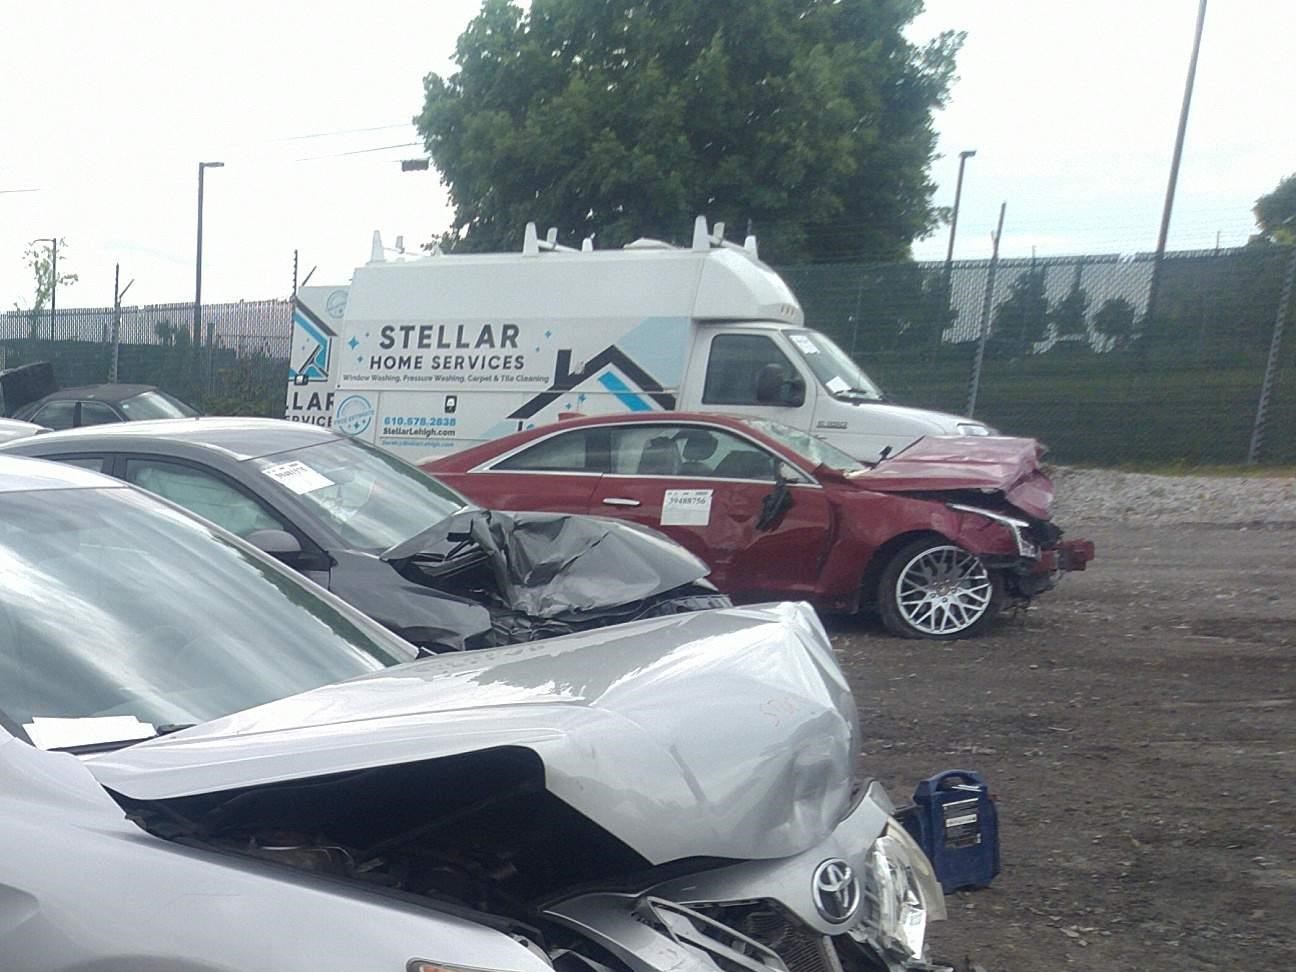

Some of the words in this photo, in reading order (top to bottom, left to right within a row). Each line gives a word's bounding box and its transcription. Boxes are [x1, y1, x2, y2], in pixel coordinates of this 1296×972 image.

[379, 324, 521, 350] STELLAR
[370, 355, 423, 370] HOME
[431, 355, 525, 370] SERVICES
[403, 374, 433, 382] Pressure
[467, 374, 492, 383] Carpet
[516, 375, 550, 384] Cleaning
[383, 427, 456, 437] StellarLehigh.com
